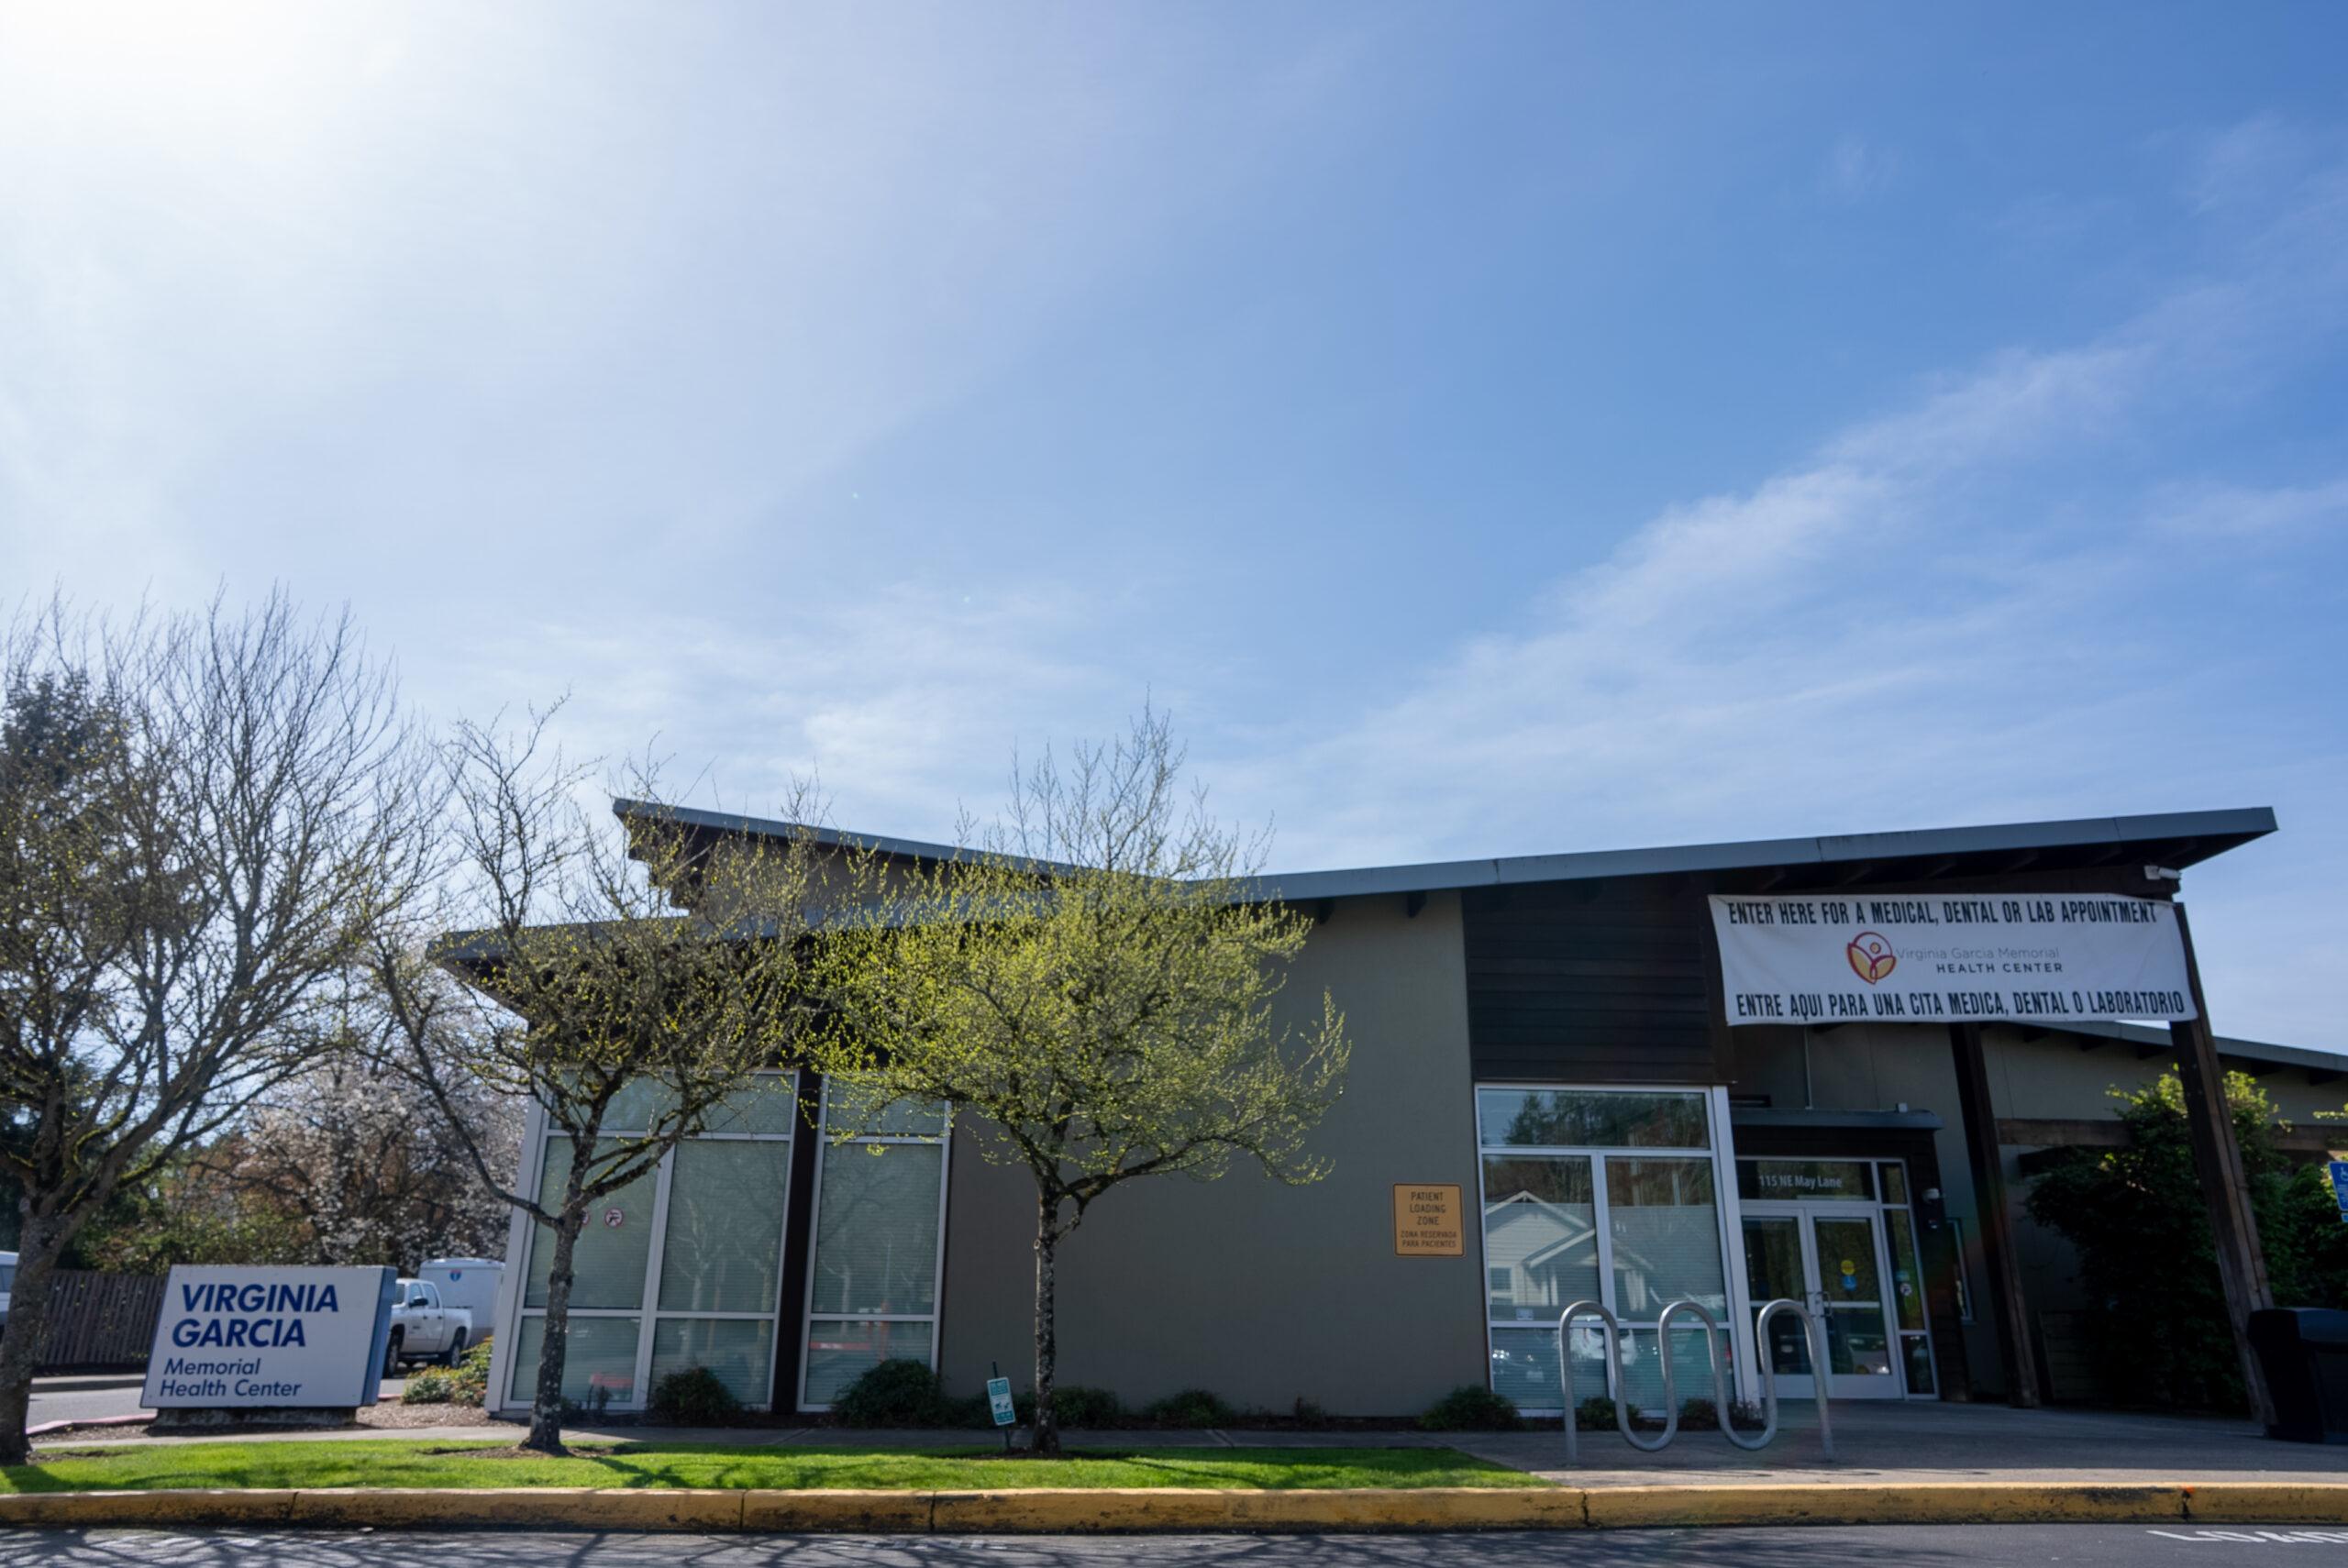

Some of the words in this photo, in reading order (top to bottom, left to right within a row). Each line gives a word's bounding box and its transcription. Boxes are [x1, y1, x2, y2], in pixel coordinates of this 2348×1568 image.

[1728, 901, 1775, 924] ENTER
[1778, 901, 1817, 924] HERE
[1822, 901, 1850, 924] FOR
[1855, 901, 1866, 923] A
[1870, 900, 1939, 926] MEDICAL,
[1943, 900, 1999, 923] DENTAL
[2002, 900, 2021, 923] OR
[2027, 900, 2055, 923] LAB
[2061, 900, 2157, 923] APPOINTMENT
[1896, 947, 1947, 961] Virginia
[1951, 947, 1995, 959] Garcia
[1998, 947, 2059, 959] Memorial
[1936, 963, 1995, 974] HEALTH
[2003, 962, 2063, 973] CENTER
[1735, 993, 1784, 1017] ENTRE
[1789, 993, 1823, 1021] AQUI
[1828, 993, 1869, 1017] PARA
[1873, 993, 1905, 1016] UNA
[1909, 992, 1944, 1015] CITA
[1947, 991, 2009, 1016] MEDICA,
[2012, 991, 2068, 1014] DENTAL
[2072, 991, 2084, 1013] O
[2088, 990, 2185, 1014] LABORATORIO
[1759, 1175, 1778, 1187] 115
[1779, 1175, 1794, 1187] NE
[1795, 1175, 1815, 1190] May
[1817, 1176, 1842, 1187] Lane
[1411, 1191, 1443, 1201] PATIENT
[1410, 1204, 1445, 1213] LOADING
[1417, 1216, 1439, 1225] ZONE
[183, 1284, 338, 1313] VIRGINIA
[172, 1319, 305, 1347] GARCIA
[163, 1358, 261, 1375] Memorial
[160, 1379, 227, 1397] Health
[235, 1378, 303, 1397] Center
[2146, 1529, 2348, 1543] LOAD
